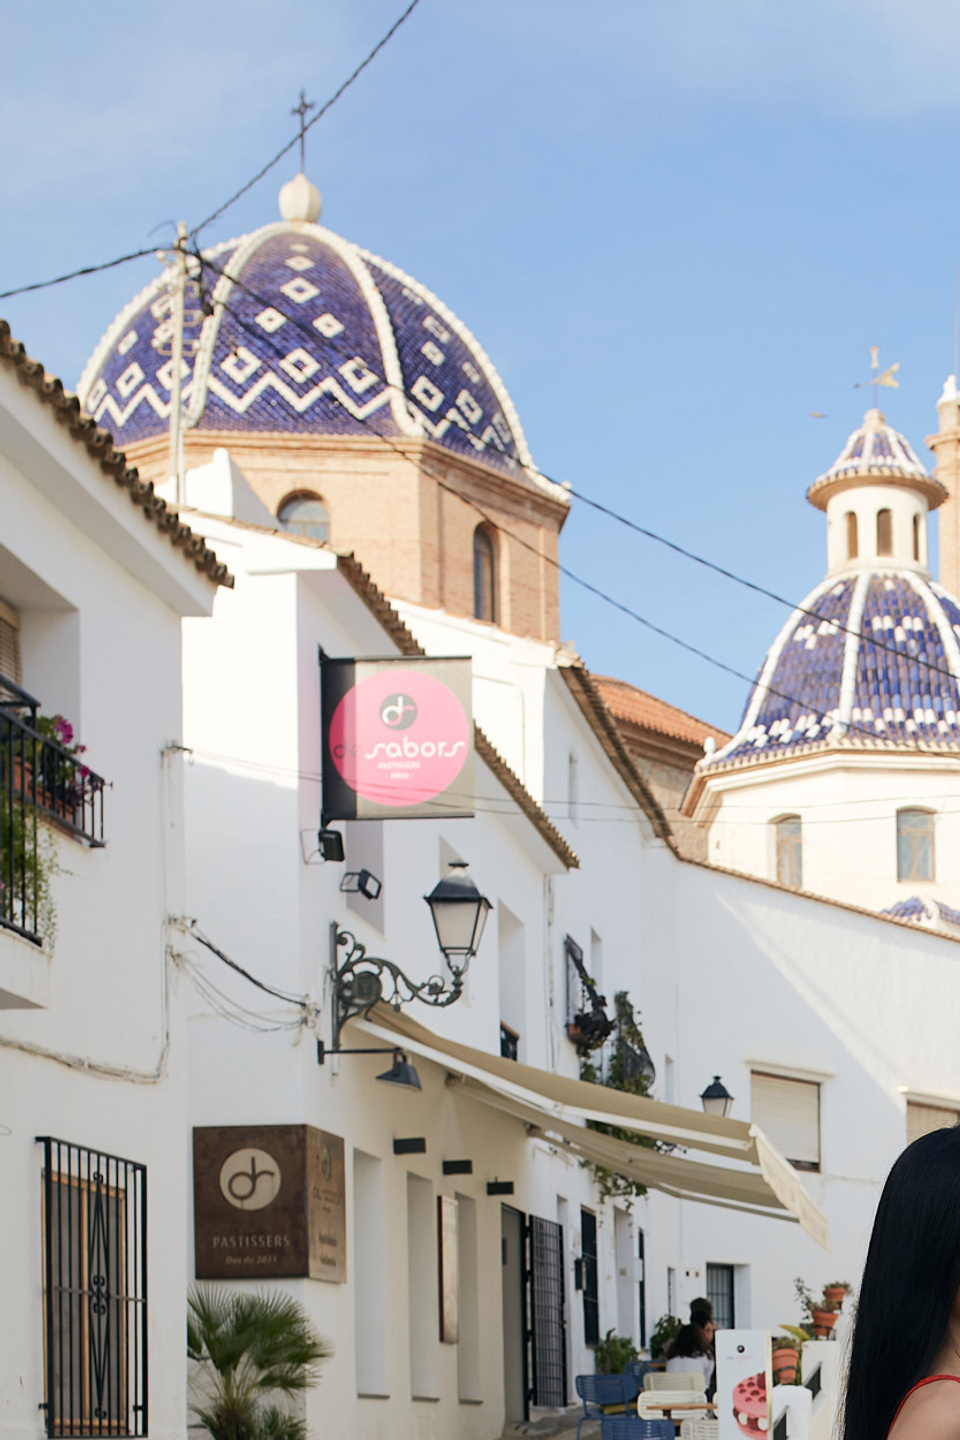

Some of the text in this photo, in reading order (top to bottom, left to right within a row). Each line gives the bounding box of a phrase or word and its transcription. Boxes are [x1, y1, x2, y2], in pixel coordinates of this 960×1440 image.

[364, 735, 466, 759] sabors
[212, 1234, 290, 1248] PASTISSERS
[256, 1254, 278, 1264] 2011
